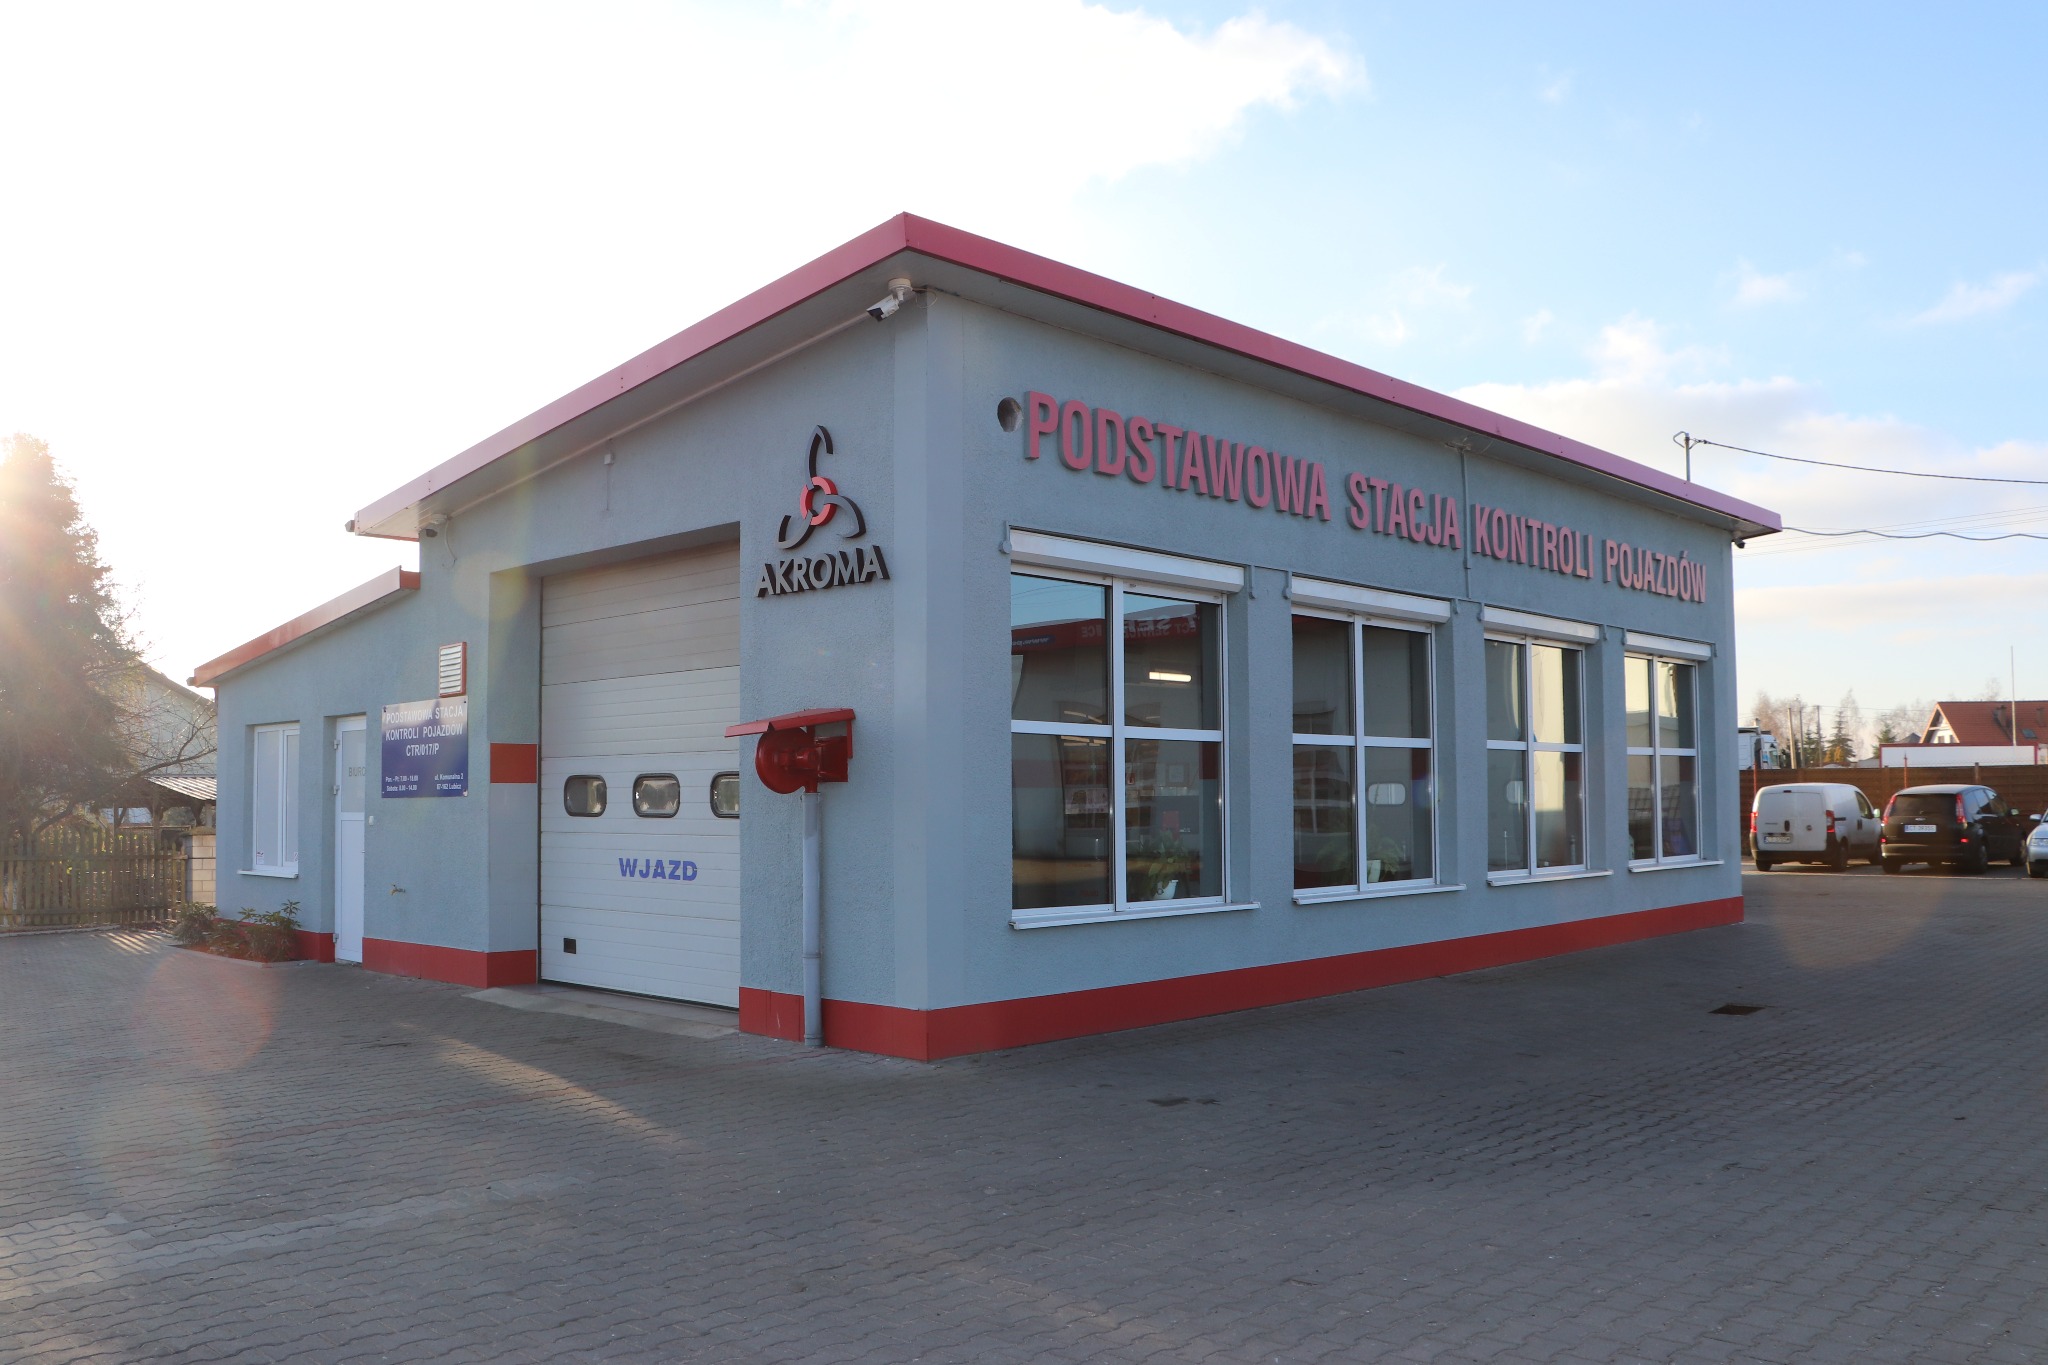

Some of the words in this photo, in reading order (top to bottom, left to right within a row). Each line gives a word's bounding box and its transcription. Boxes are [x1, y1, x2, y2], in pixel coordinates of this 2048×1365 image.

[1025, 390, 1331, 521] PODSTAWOWA
[1344, 471, 1462, 549] STACJA
[1471, 503, 1594, 579] KONTROLI
[1602, 539, 1706, 603] POJAZDÓW
[754, 545, 890, 598] AKROMA
[386, 709, 433, 724] PODSTAWOWA
[435, 705, 463, 719] STACJA
[385, 726, 419, 741] KONTROLI
[422, 721, 463, 738] POJAZDÓW
[405, 743, 440, 757] CTR/017/P
[618, 857, 698, 881] WJAZD
